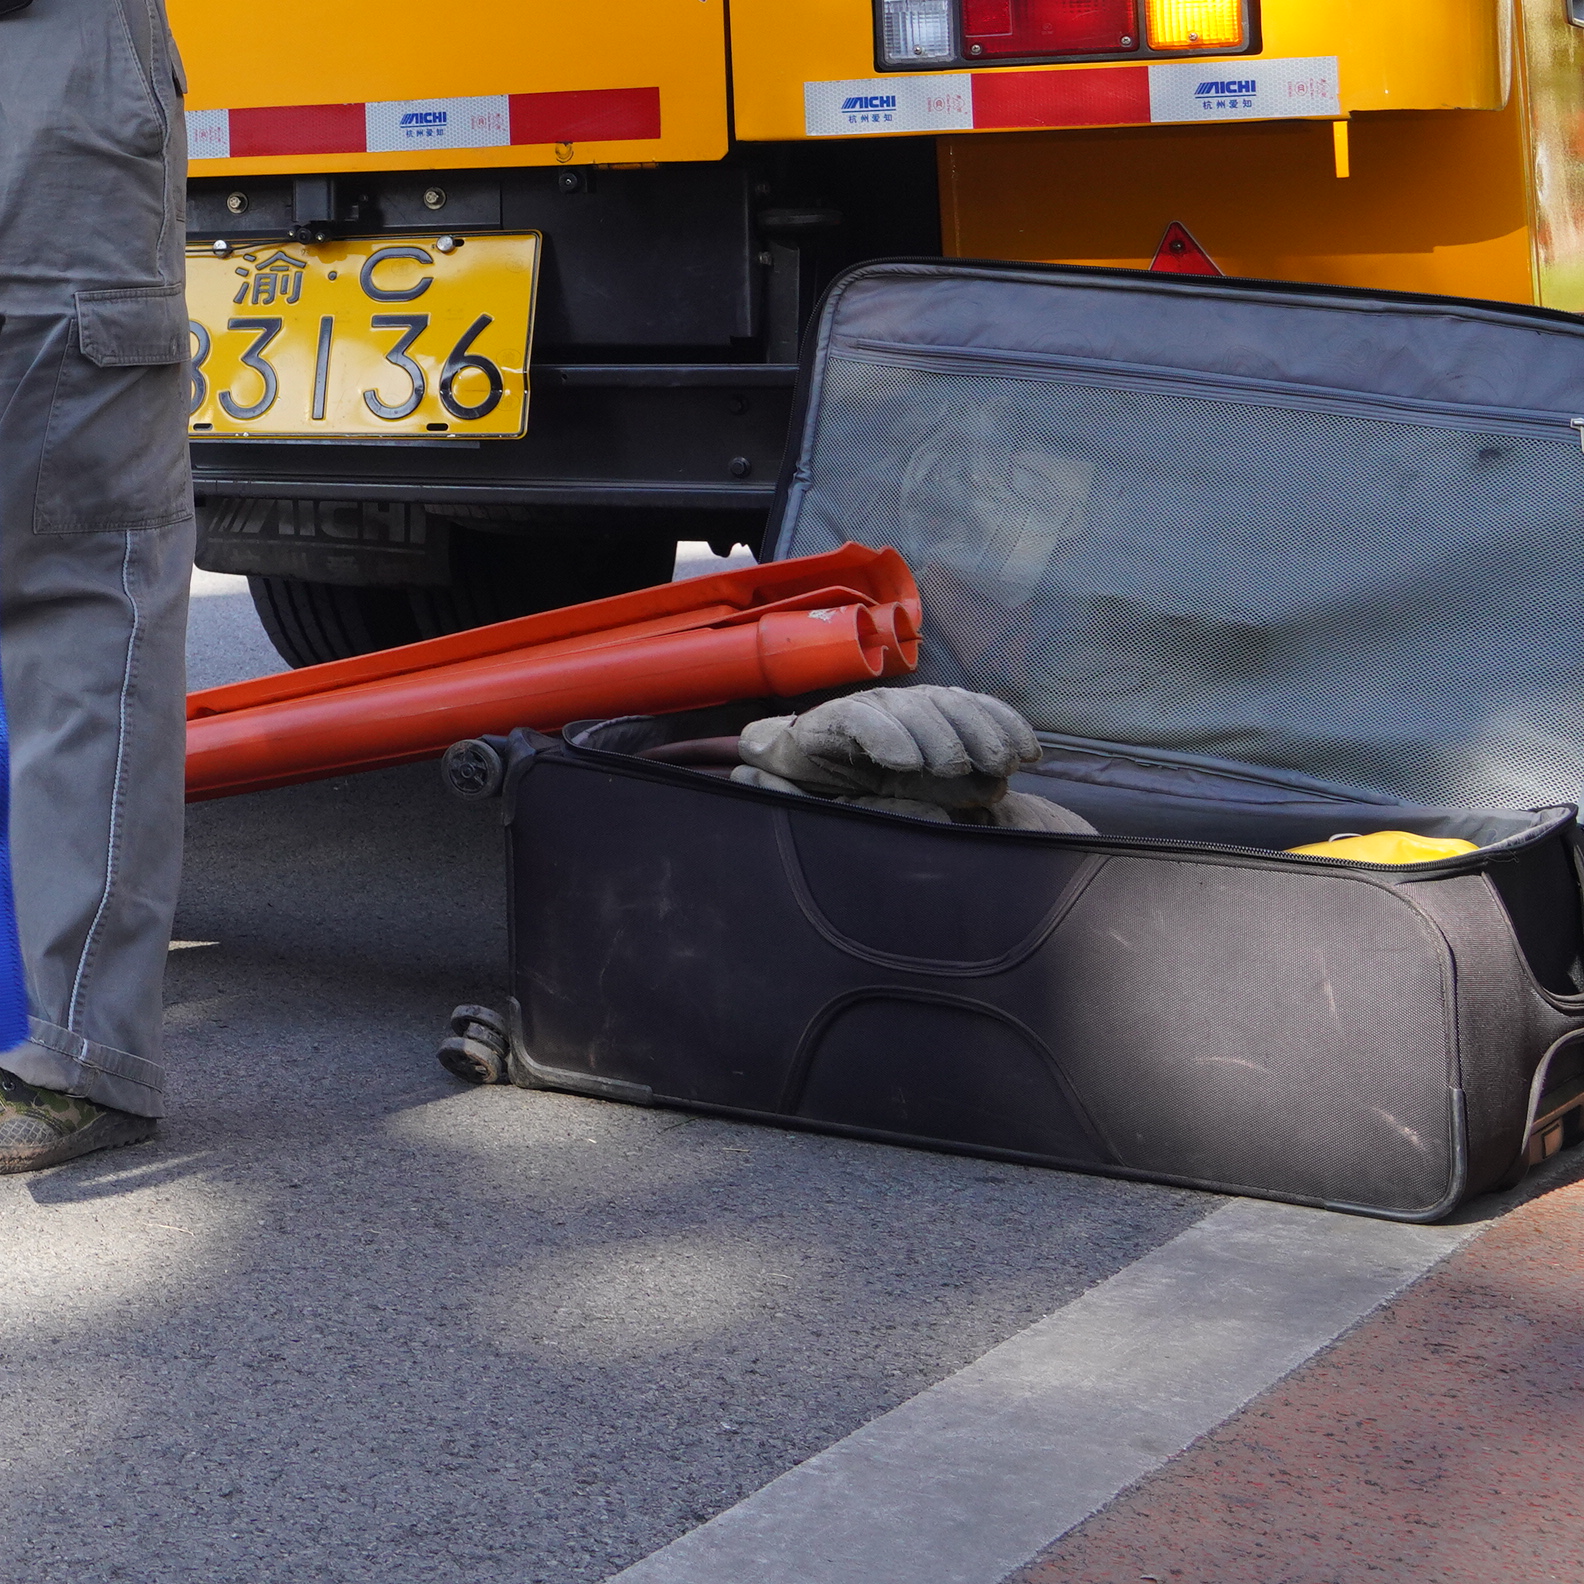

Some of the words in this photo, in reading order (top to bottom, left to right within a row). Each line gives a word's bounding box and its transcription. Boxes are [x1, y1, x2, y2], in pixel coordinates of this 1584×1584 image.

[1203, 79, 1257, 95] AICHI
[848, 95, 897, 109] AICHI
[1202, 99, 1253, 110] 杭州爱知
[407, 111, 447, 125] AICHI
[848, 114, 893, 124] 杭州爱知
